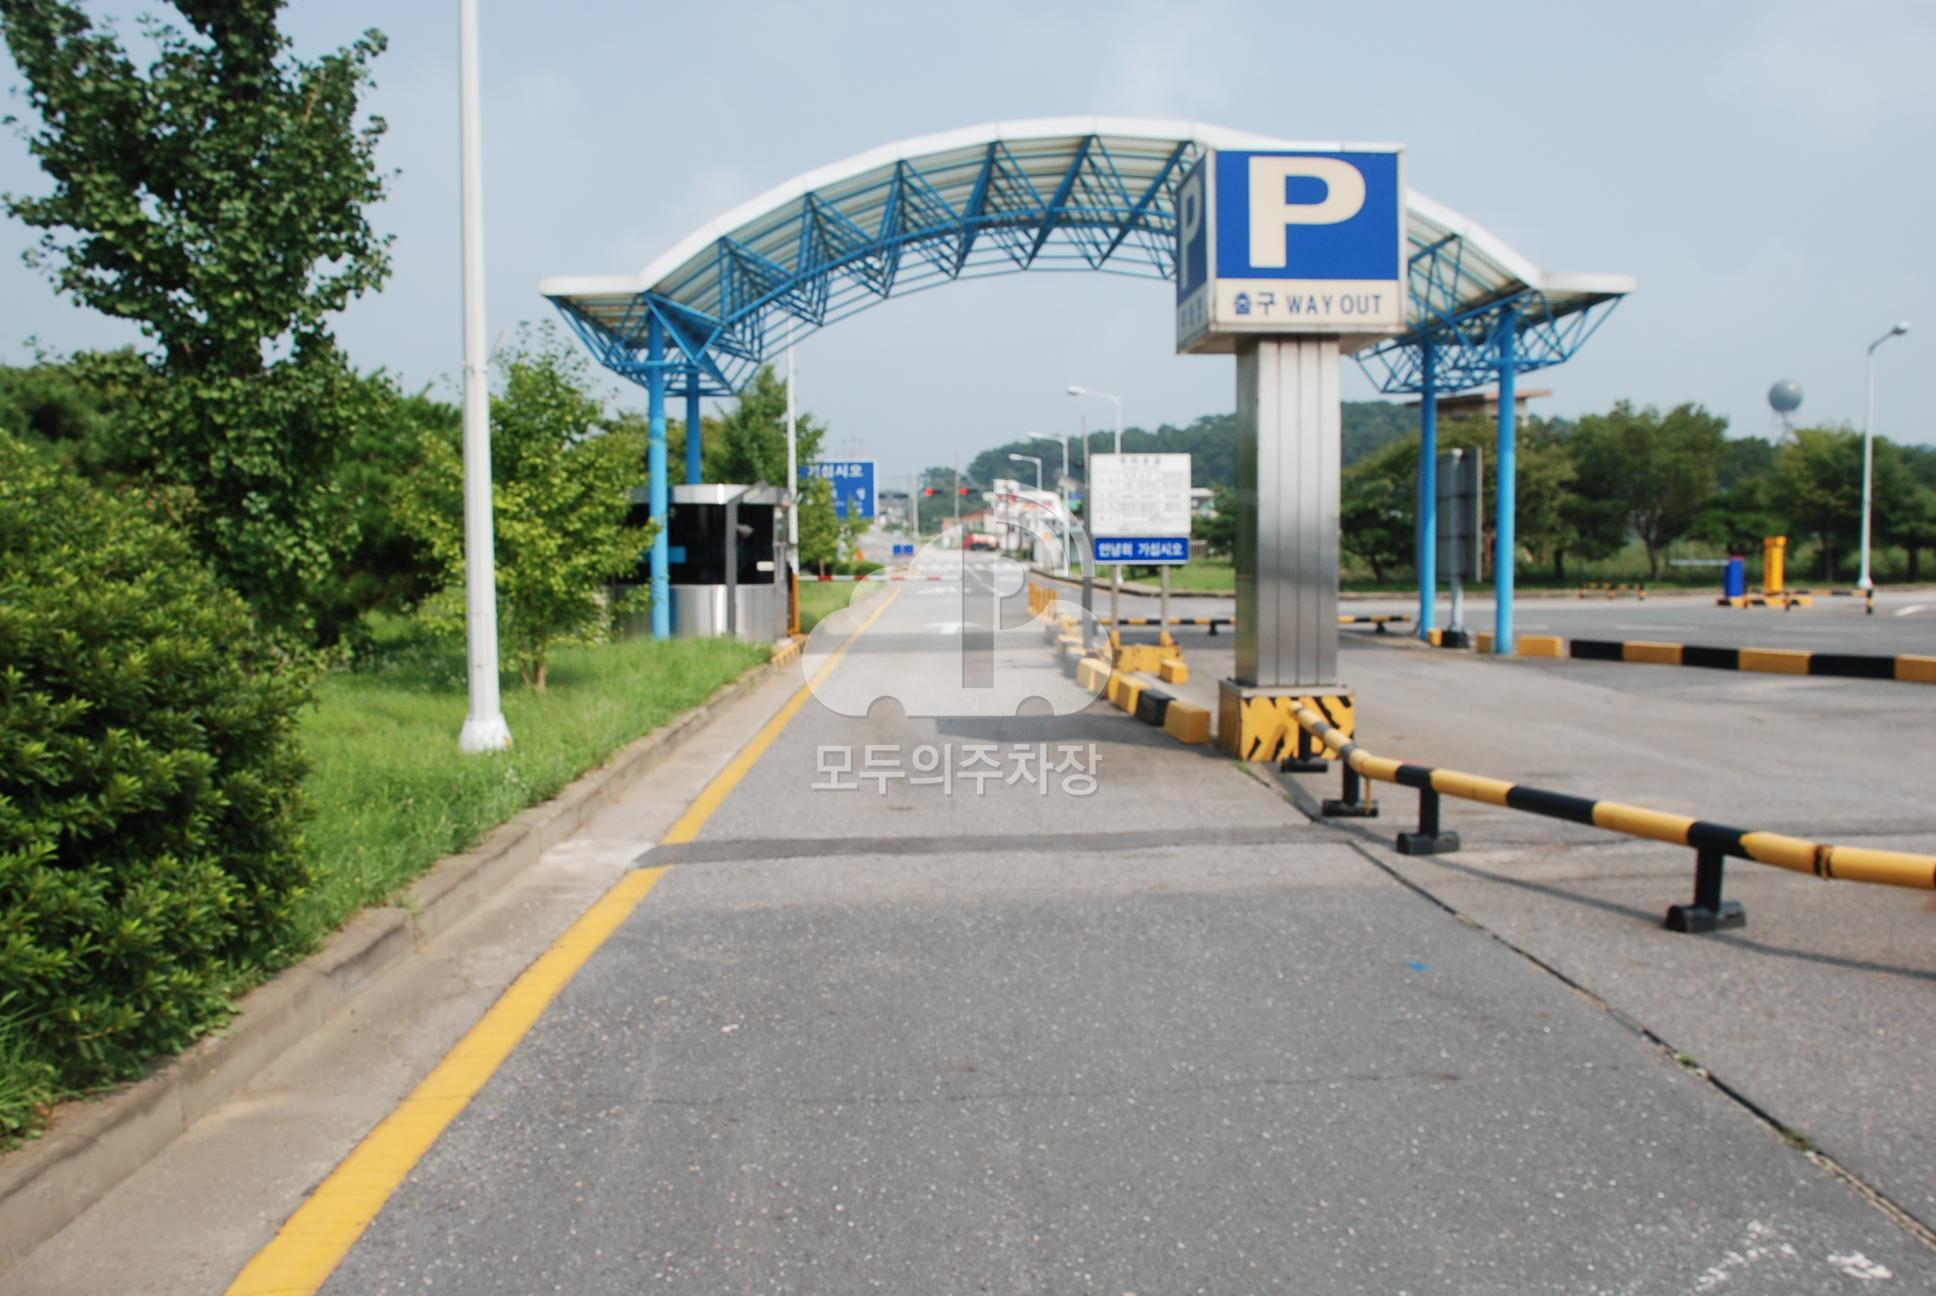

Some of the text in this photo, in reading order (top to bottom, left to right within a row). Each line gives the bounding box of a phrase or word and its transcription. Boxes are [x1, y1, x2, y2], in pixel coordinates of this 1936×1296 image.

[1180, 174, 1203, 291] P
[1248, 156, 1367, 269] P
[1234, 291, 1384, 316] 출구 WAY OUT
